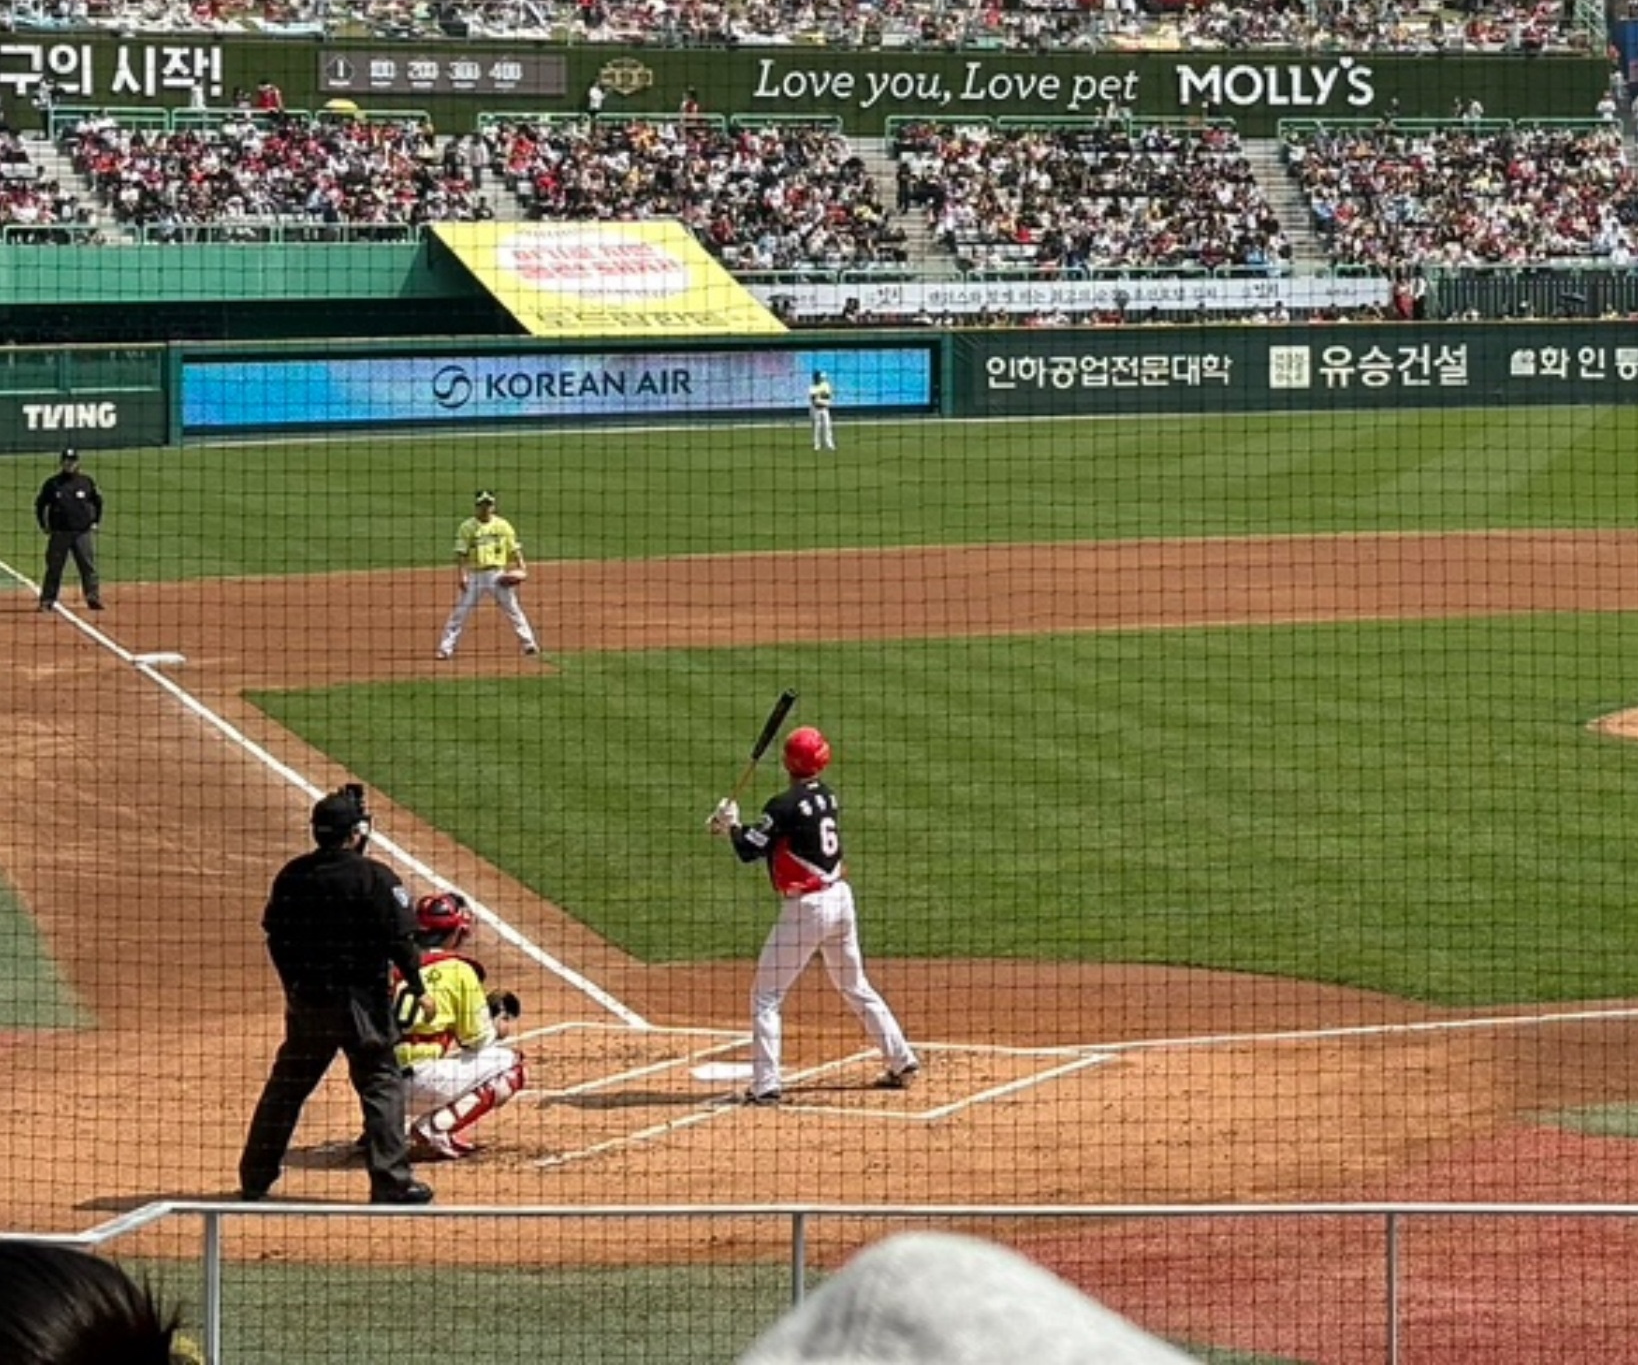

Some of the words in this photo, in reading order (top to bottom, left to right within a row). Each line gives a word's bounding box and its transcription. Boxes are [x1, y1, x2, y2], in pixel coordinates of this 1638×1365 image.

[111, 46, 222, 97] 시작!
[753, 60, 855, 99] Love
[861, 70, 953, 107] you,
[960, 62, 1061, 100] Love
[1067, 69, 1139, 107] pet
[1177, 57, 1375, 106] MOLLY'S
[485, 372, 626, 401] KOREAN
[635, 369, 692, 397] AIR
[985, 353, 1233, 389] 인하공업전문대학
[1319, 344, 1469, 387] 유승건설
[22, 402, 117, 430] TVING
[820, 817, 838, 855] 6
